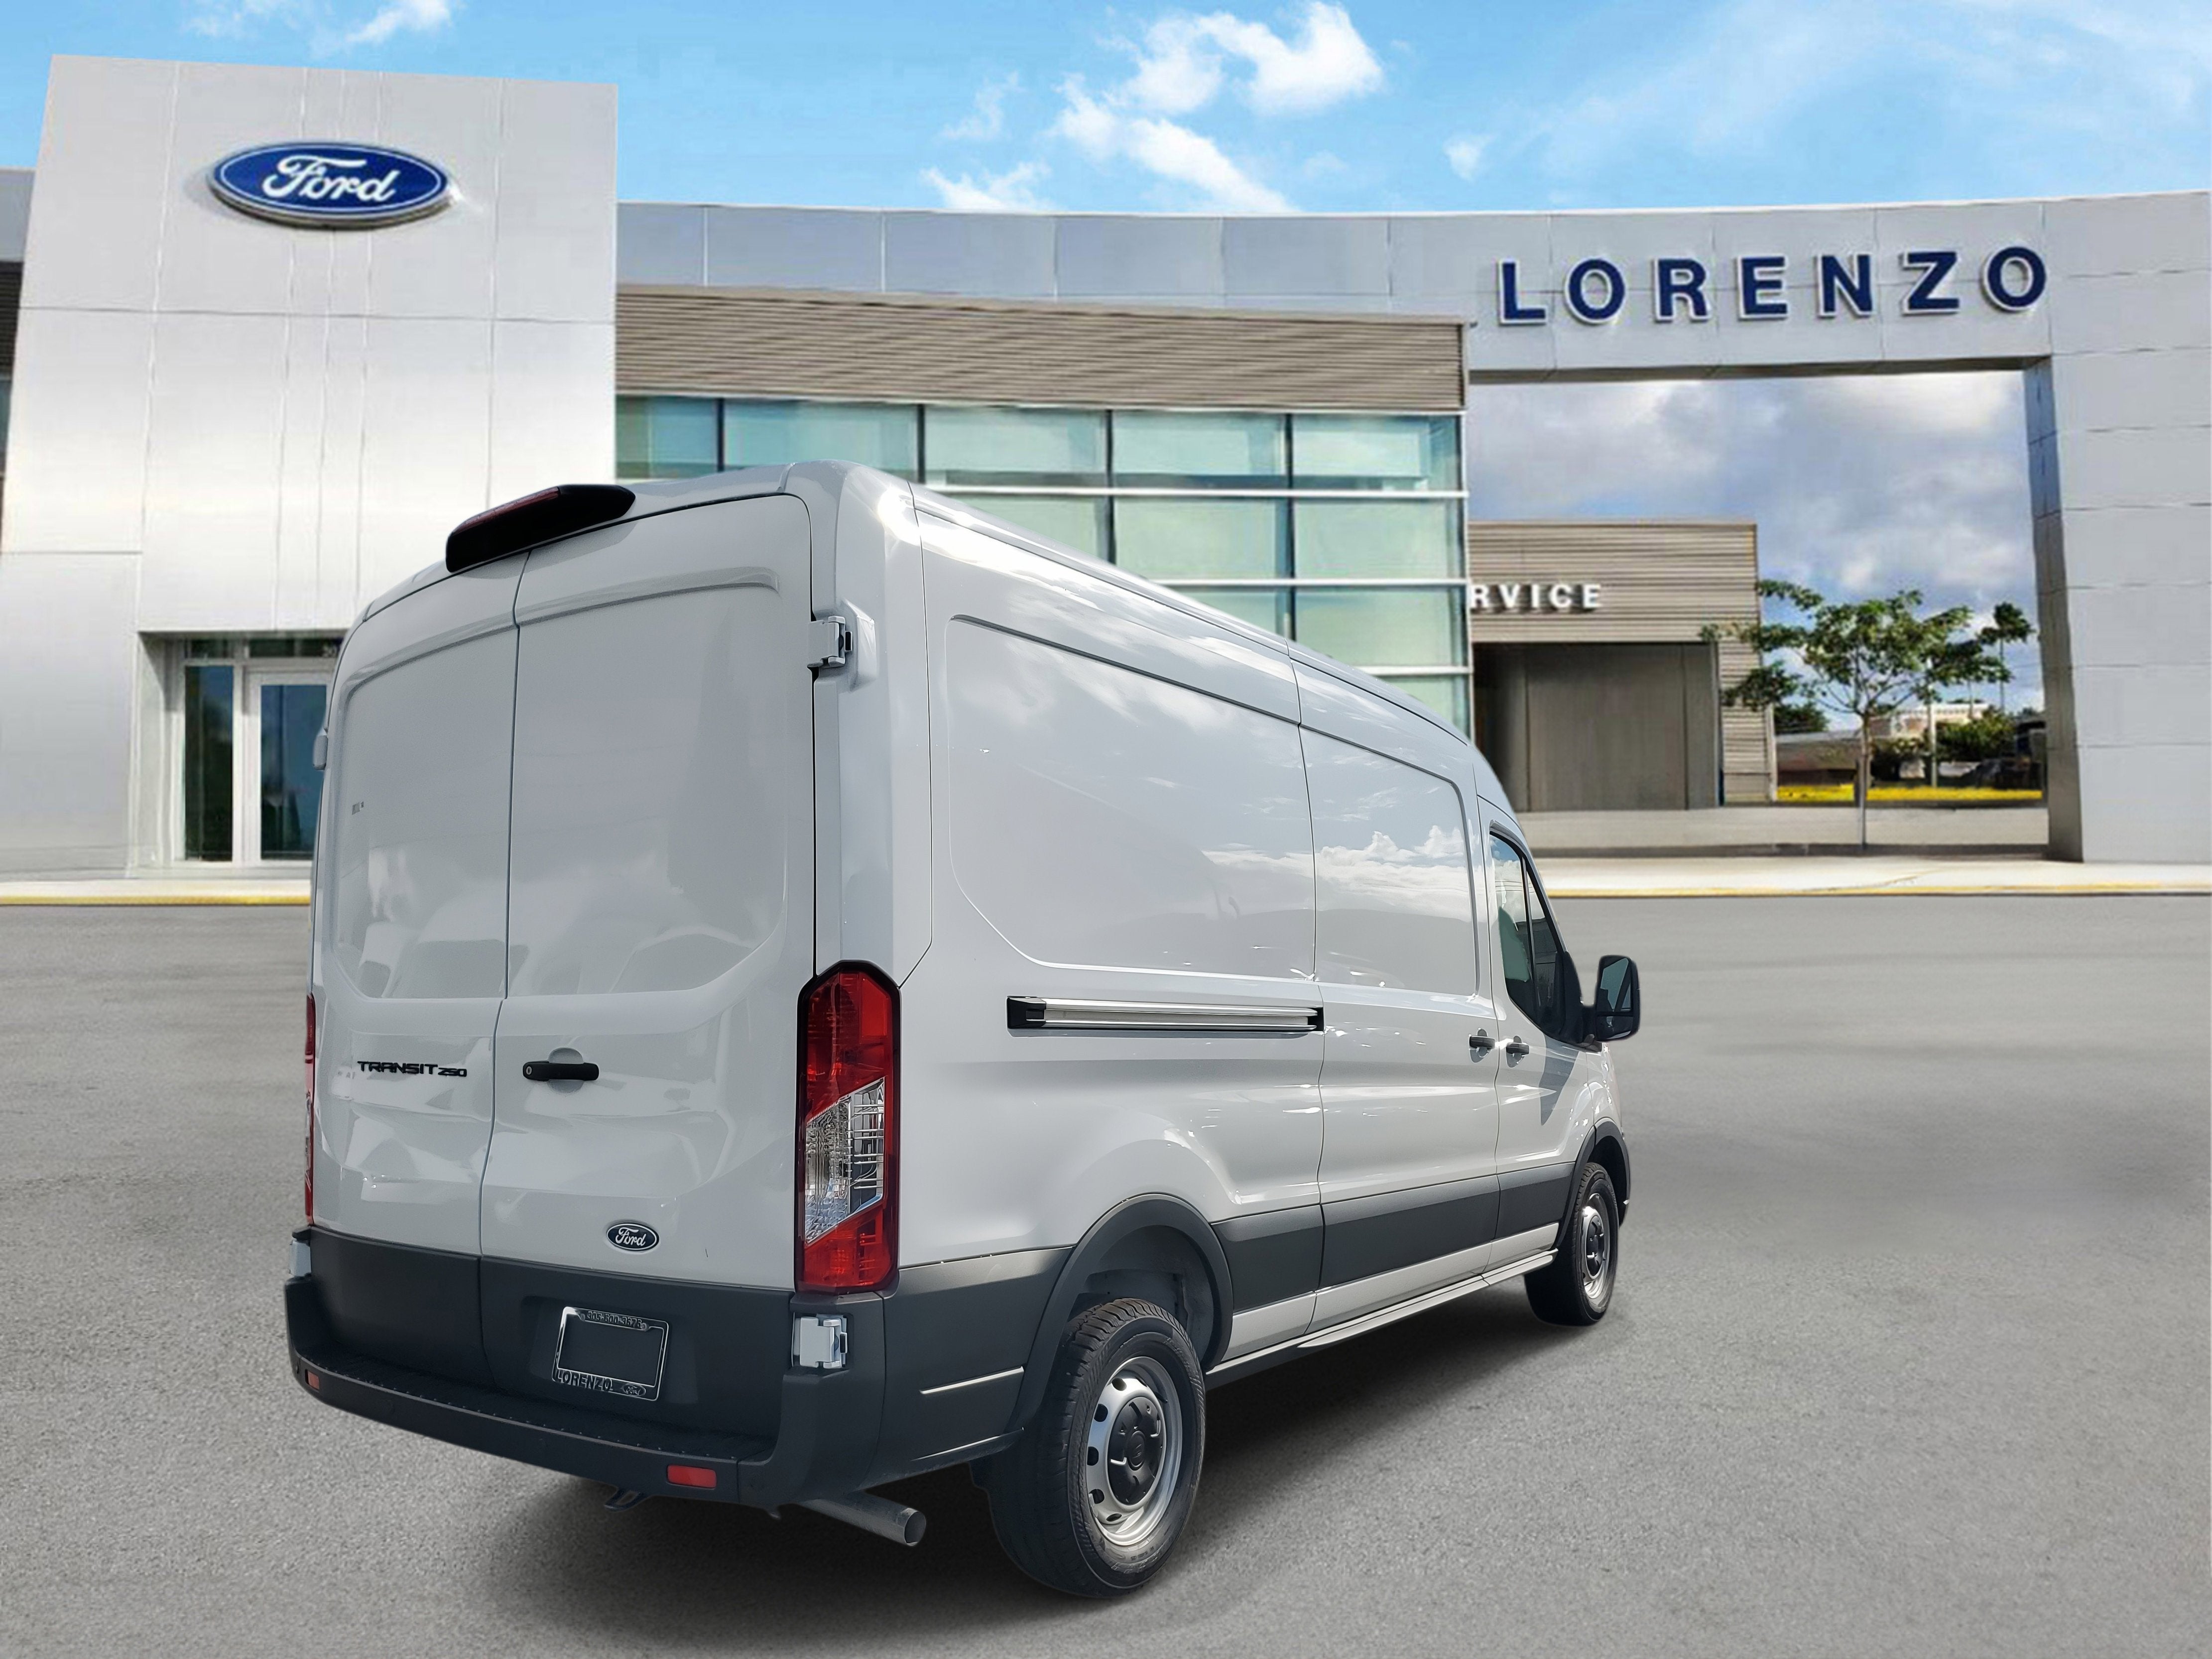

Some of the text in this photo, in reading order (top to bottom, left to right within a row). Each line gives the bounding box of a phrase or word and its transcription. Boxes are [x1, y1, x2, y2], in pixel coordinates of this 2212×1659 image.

[262, 154, 399, 201] Ford
[1499, 246, 2048, 325] LORENZO
[357, 1061, 438, 1074] TRANSIT
[615, 1227, 646, 1246] Ford
[554, 1370, 613, 1392] LORENZO
